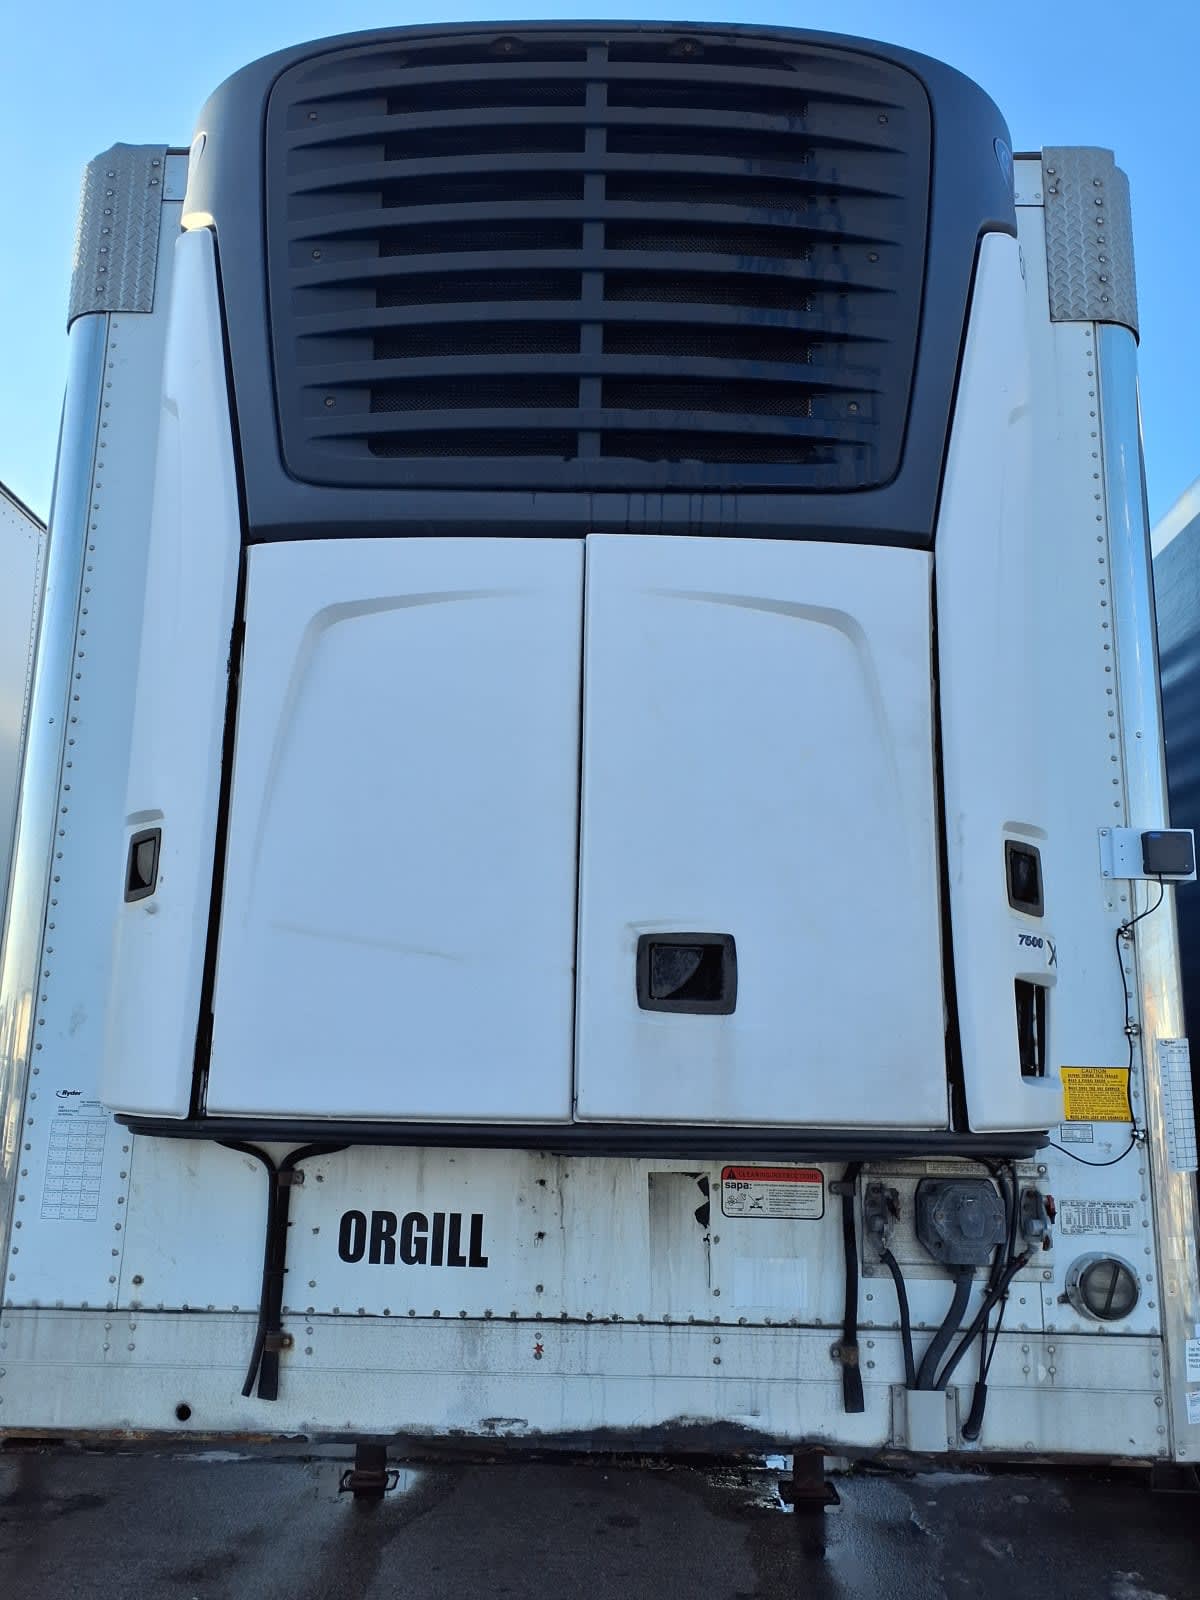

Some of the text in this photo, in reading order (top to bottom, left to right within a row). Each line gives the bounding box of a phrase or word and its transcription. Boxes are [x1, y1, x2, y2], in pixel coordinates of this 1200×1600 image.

[1018, 933, 1044, 949] 7500
[62, 1089, 83, 1097] Ryder
[338, 1210, 489, 1268] ORGILL
